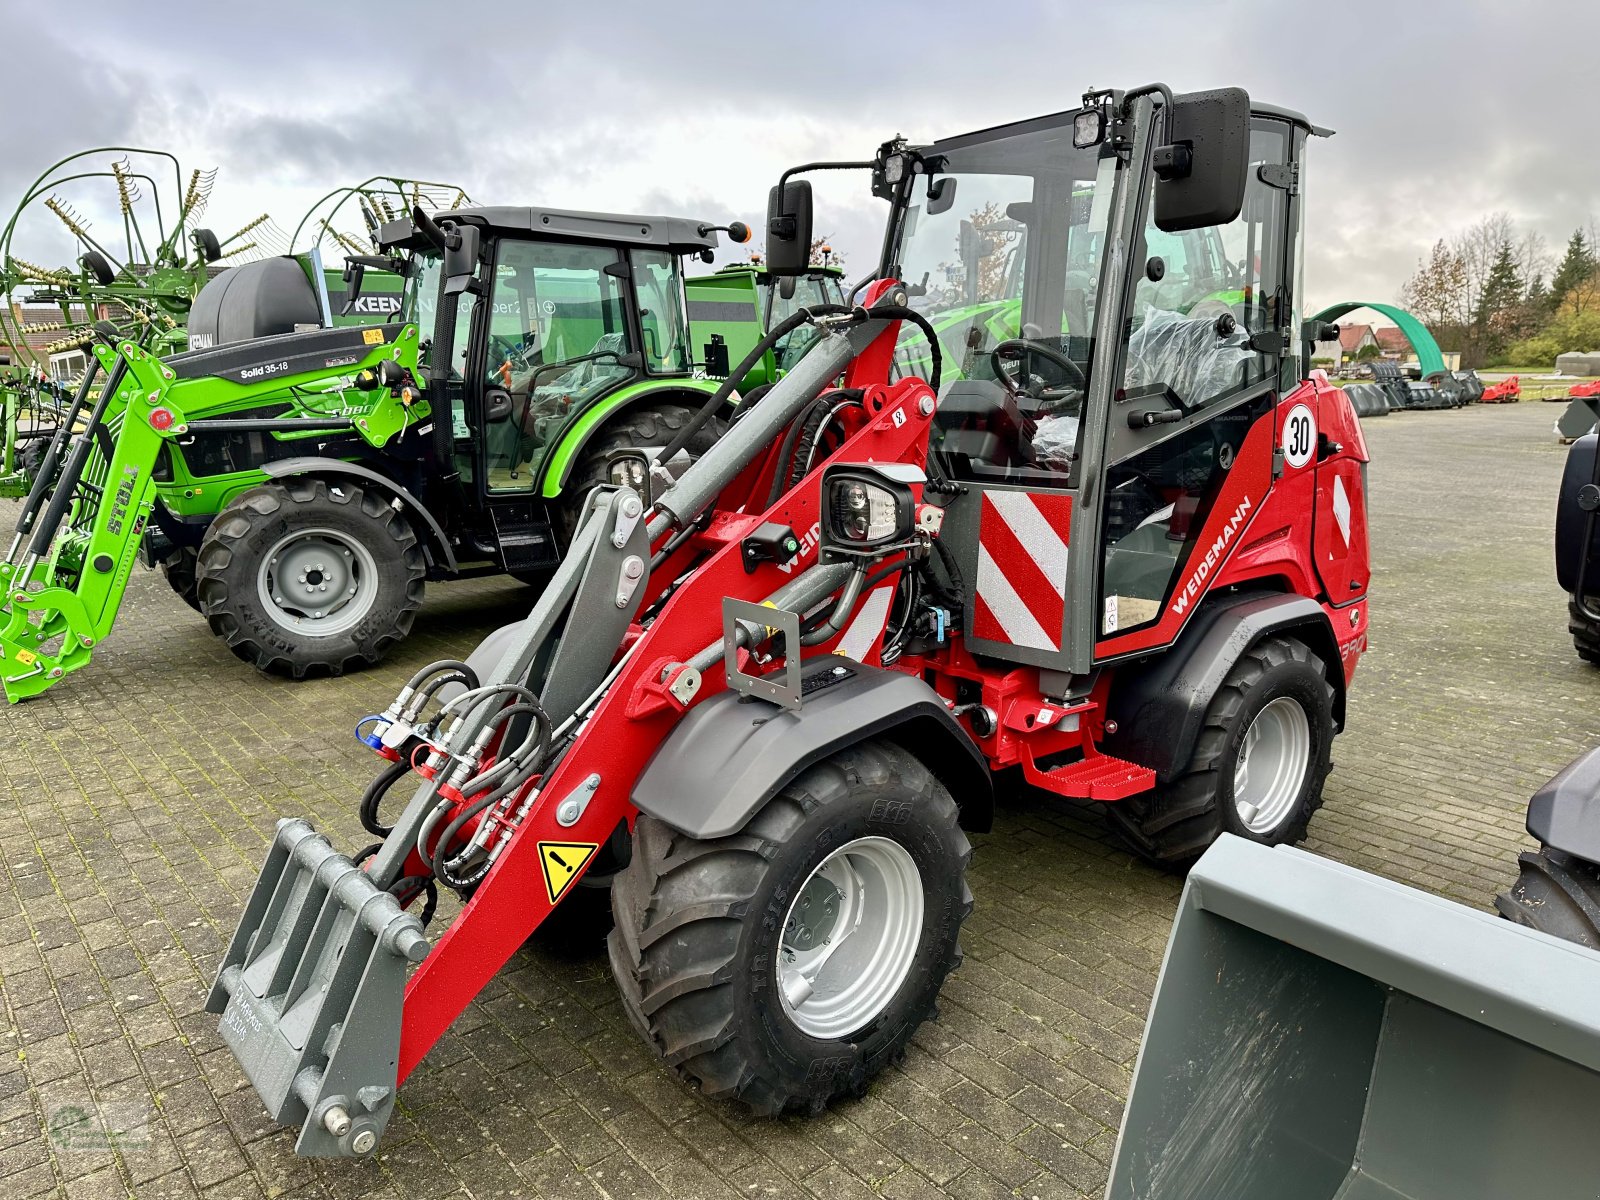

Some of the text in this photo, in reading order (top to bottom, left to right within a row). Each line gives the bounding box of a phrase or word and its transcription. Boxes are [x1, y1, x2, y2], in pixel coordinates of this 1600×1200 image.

[240, 361, 289, 379] Solid 35-18
[1290, 416, 1309, 456] 30
[1172, 495, 1252, 615] WEIDEMANN
